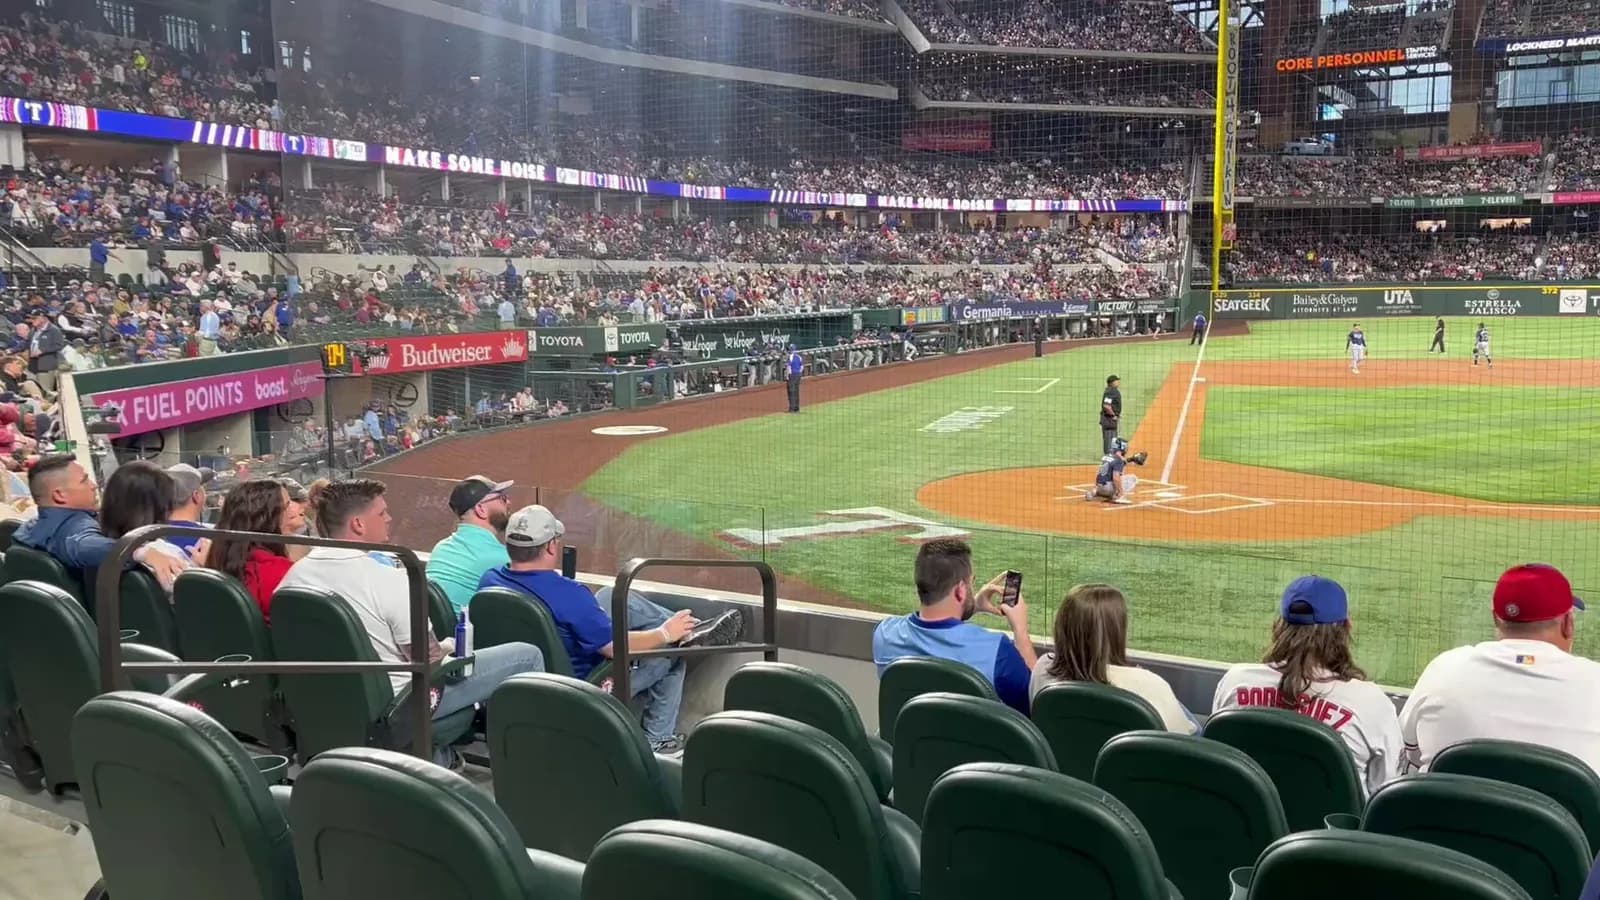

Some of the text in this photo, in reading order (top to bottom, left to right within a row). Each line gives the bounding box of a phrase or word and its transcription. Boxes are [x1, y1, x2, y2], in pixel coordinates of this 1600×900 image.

[1506, 39, 1564, 52] LOCKHEED
[1276, 49, 1404, 72] CORE PERSONNEL
[386, 146, 441, 169] MAKE
[447, 153, 494, 174] SOME
[500, 160, 545, 181] NOISE
[878, 195, 994, 210] MAKE SOME NOISE
[1384, 290, 1414, 304] UTA
[1541, 287, 1558, 295] 372
[963, 302, 1012, 318] Germania
[1098, 301, 1133, 312] VICTORY
[1214, 297, 1271, 312] SEATGEEK
[1464, 300, 1521, 308] ESTRELLA
[1469, 307, 1516, 315] JALISCO
[540, 336, 583, 347] TOYOTA
[620, 331, 650, 345] TOYOTA
[401, 342, 491, 368] Budweiser
[134, 391, 181, 424] FUEL
[186, 381, 243, 414] POINTS
